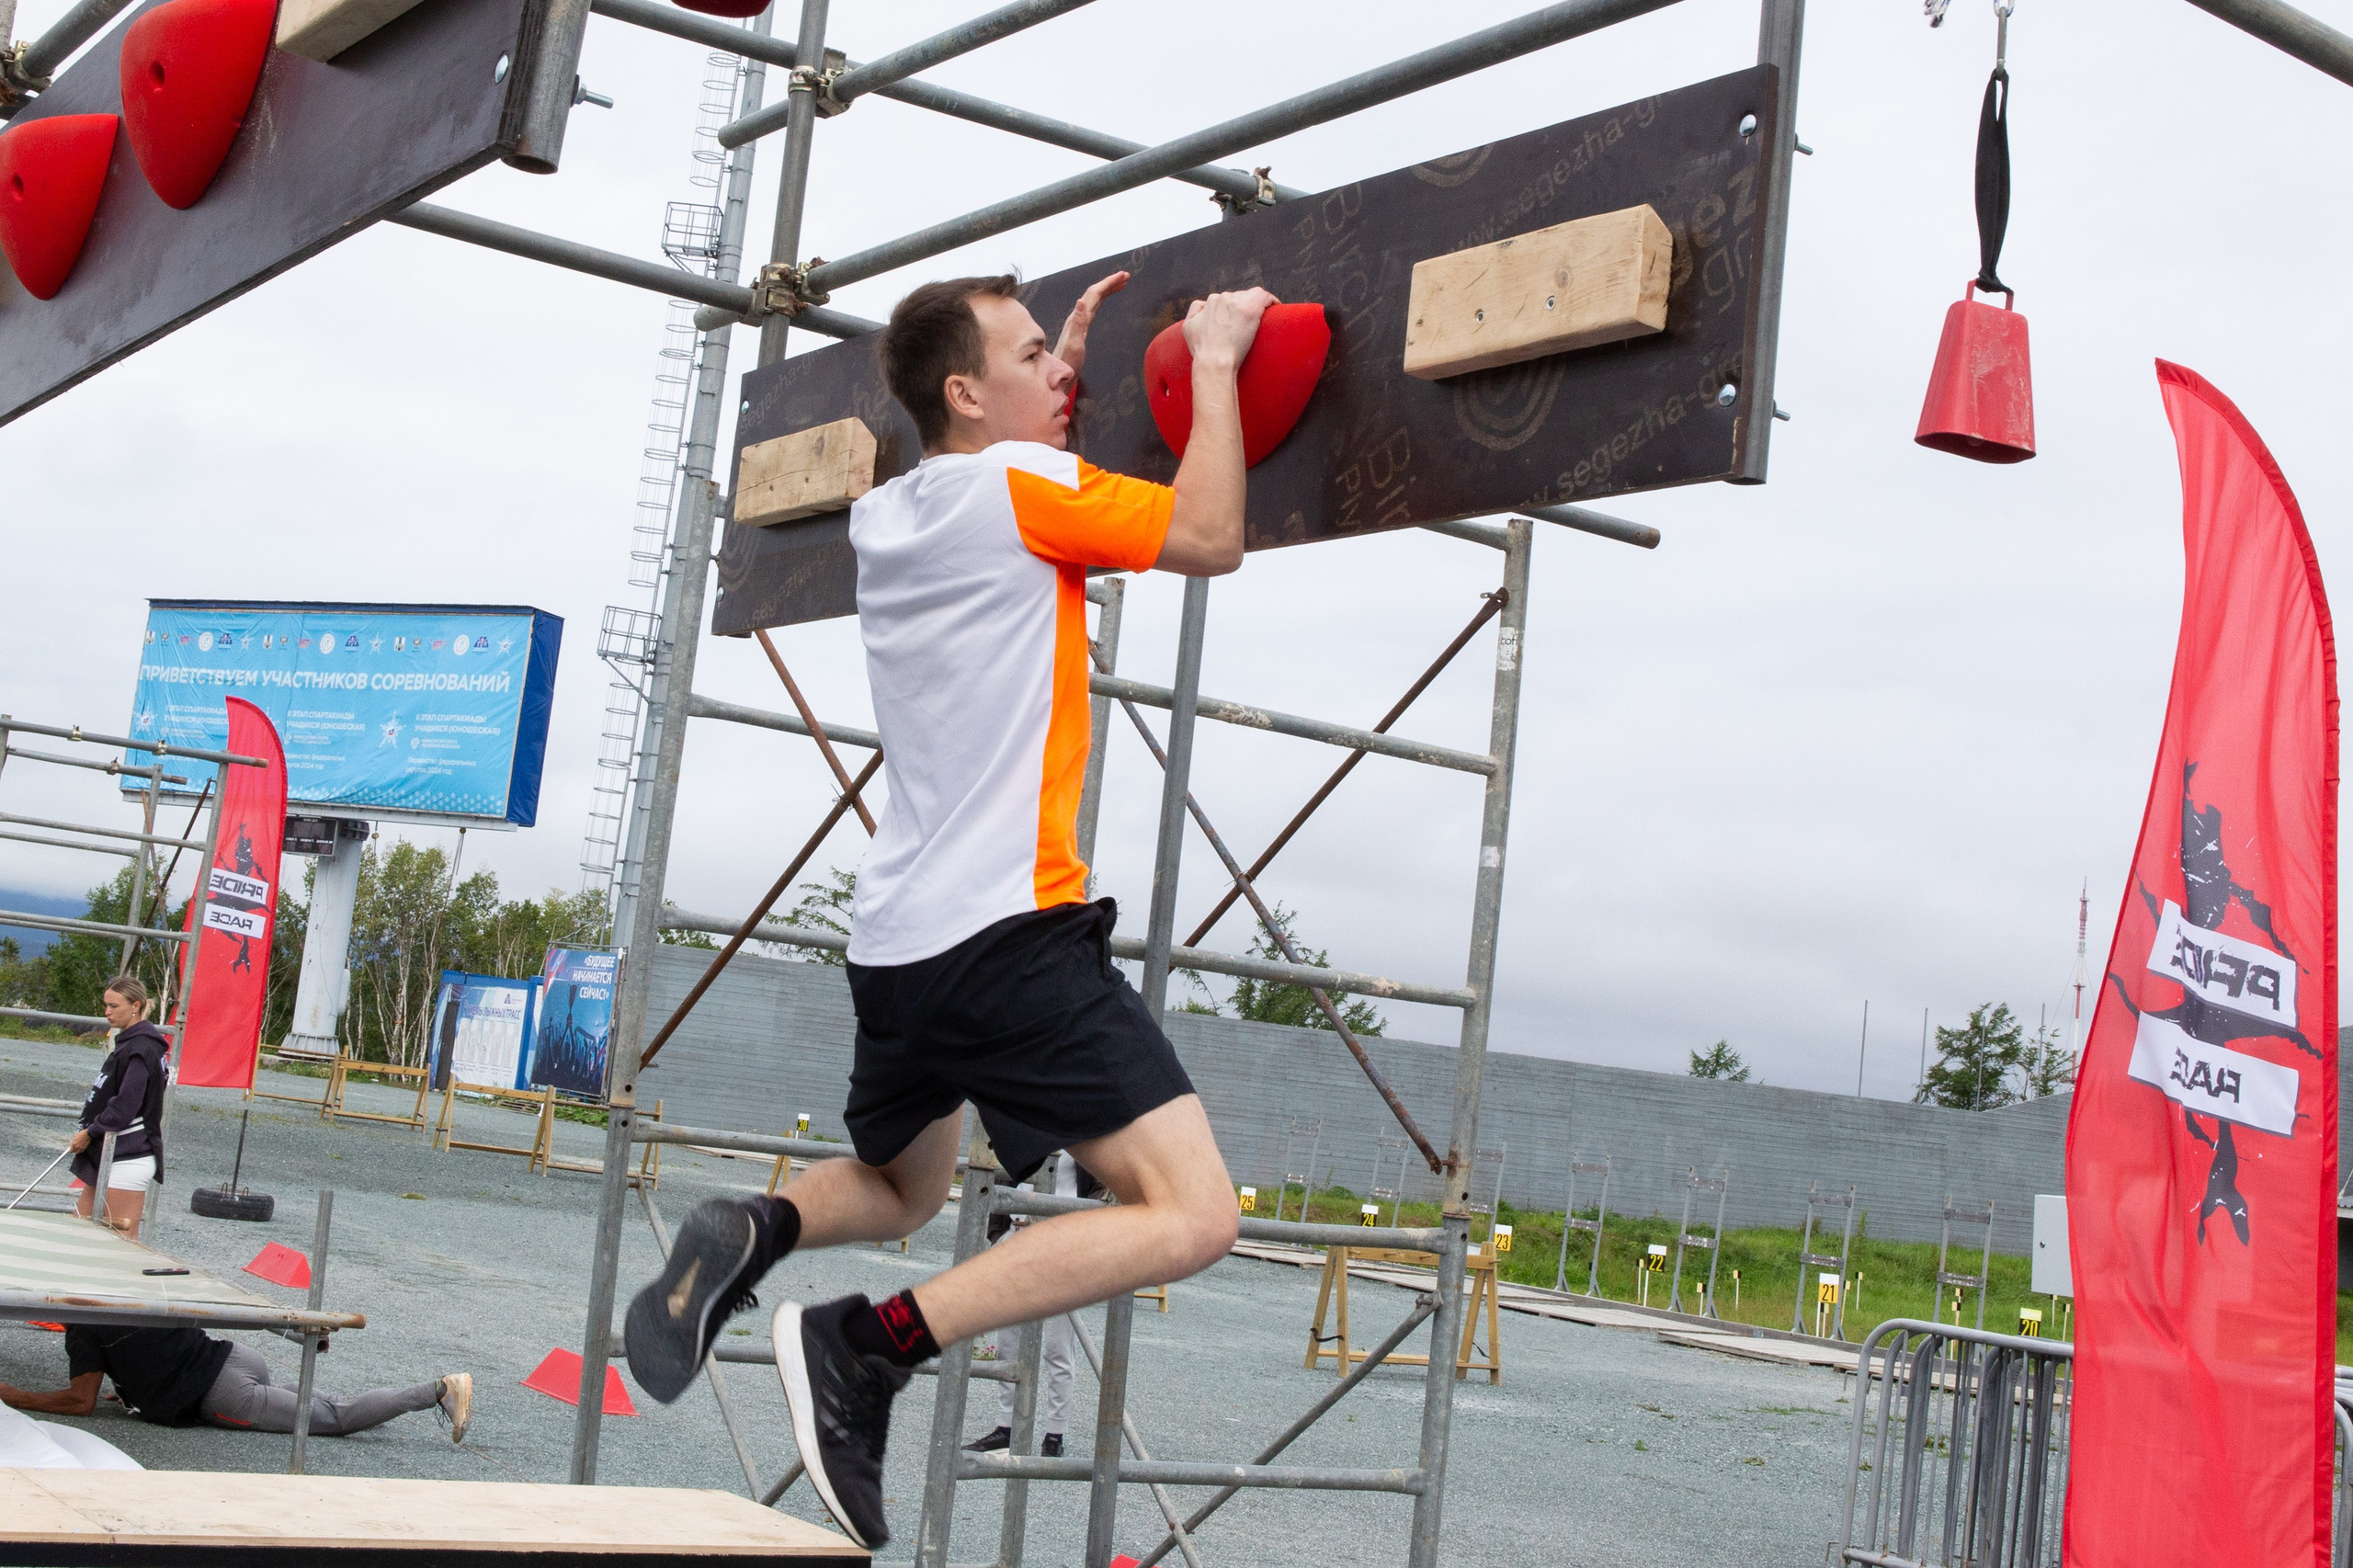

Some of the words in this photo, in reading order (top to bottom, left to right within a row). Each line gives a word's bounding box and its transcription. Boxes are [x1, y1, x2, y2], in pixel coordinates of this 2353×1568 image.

[140, 665, 258, 687] ПРИВЕТСТВУЕМ
[261, 670, 368, 690] УЧАСТНИКОВ
[370, 671, 511, 693] СОРЕВНОВАНИЙ
[309, 711, 355, 720] СПАРТАКИАДЫ
[437, 714, 487, 723] СПАРТАКИАДЫ
[572, 970, 613, 984] НАЧИНАЕТСЯ
[798, 1119, 808, 1131] 30
[1242, 1195, 1254, 1210] 25
[1362, 1213, 1375, 1227] 24
[1496, 1233, 1509, 1250] 23
[1649, 1254, 1665, 1272] 22
[1822, 1283, 1836, 1302] 21
[2022, 1319, 2039, 1337] 20
